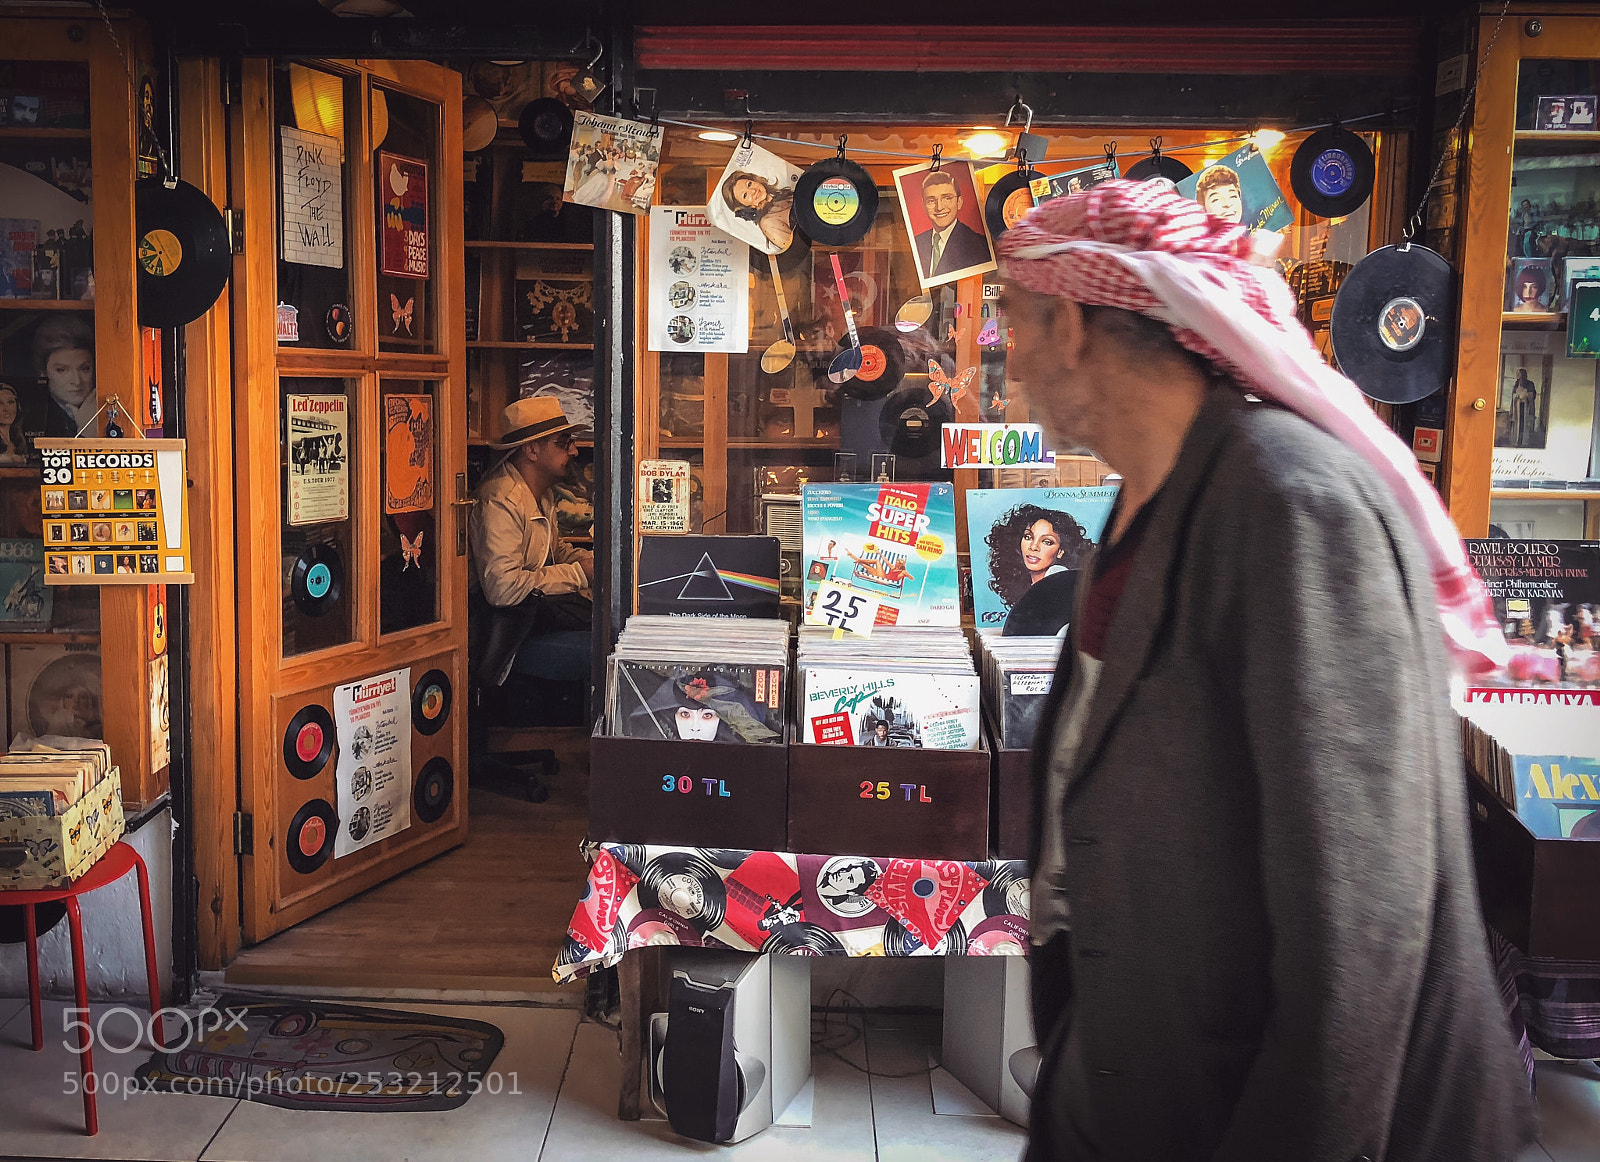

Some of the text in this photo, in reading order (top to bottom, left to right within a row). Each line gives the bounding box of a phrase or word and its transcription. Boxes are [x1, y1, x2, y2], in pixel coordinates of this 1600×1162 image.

[575, 115, 617, 130] Johann
[296, 142, 324, 170] PINK
[297, 165, 332, 198] FLOYD
[300, 195, 325, 221] THE
[297, 222, 335, 247] WALL
[409, 230, 426, 246] DAYS
[408, 245, 427, 260] PEACE
[408, 259, 427, 274] MUSIC
[292, 398, 345, 415] Led Zeppelin
[42, 456, 71, 468] TOP
[76, 454, 154, 469] RECORDS
[43, 468, 72, 484] 30
[660, 470, 686, 478] DYLAN
[884, 495, 918, 511] ITALO
[865, 503, 931, 535] SUPER
[876, 525, 911, 544] HITS
[916, 543, 927, 552] SAN
[1469, 542, 1559, 556] RAVEL BOLERO
[1468, 555, 1561, 568] DEBUSSY LA MER
[1480, 579, 1503, 588] erliner
[1507, 589, 1526, 598] VON
[822, 590, 867, 618] 25
[825, 612, 853, 632] TL
[757, 671, 765, 701] DONNA
[770, 672, 778, 707] SUMMER
[809, 678, 895, 702] BEVERLY HILLS
[833, 690, 878, 715] Cop
[1471, 691, 1594, 706] KAMPANYA
[661, 774, 731, 798] 30 TL
[1524, 763, 1600, 801] Alex
[860, 780, 932, 804] 25 TL
[681, 876, 704, 905] COLUMBIA
[891, 860, 911, 917] ELVIS
[658, 911, 690, 930] CALIFORNIA
[663, 920, 680, 931] GIRLS
[1003, 919, 1030, 937] CALIFOR
[1008, 929, 1025, 941] GIRLS
